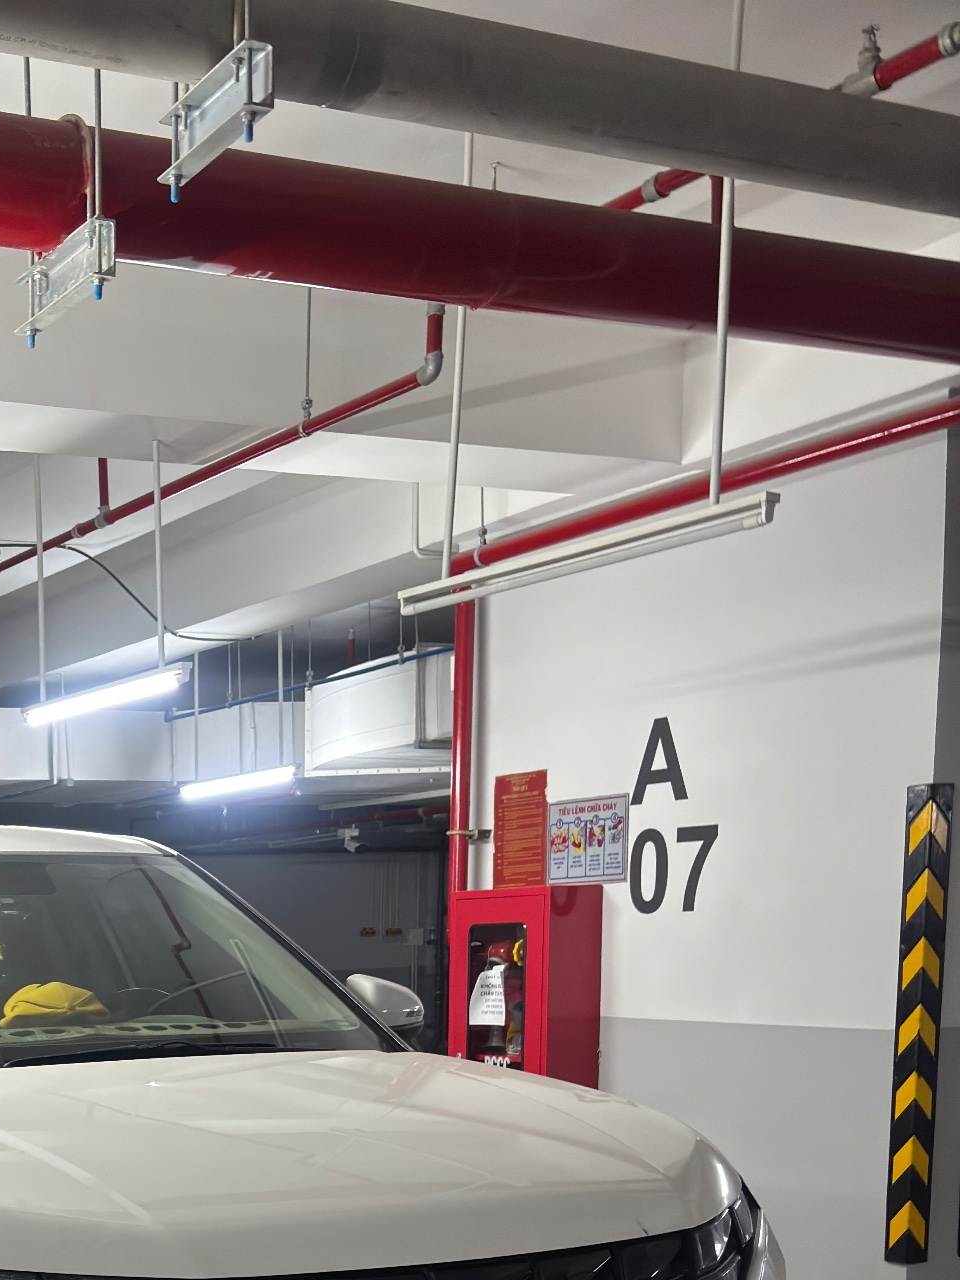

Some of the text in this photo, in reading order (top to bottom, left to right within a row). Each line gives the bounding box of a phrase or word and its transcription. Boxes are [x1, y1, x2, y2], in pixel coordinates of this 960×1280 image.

[630, 716, 689, 806] A
[587, 802, 601, 813] CHỮA
[602, 801, 617, 811] CHÁY
[629, 823, 719, 915] 07
